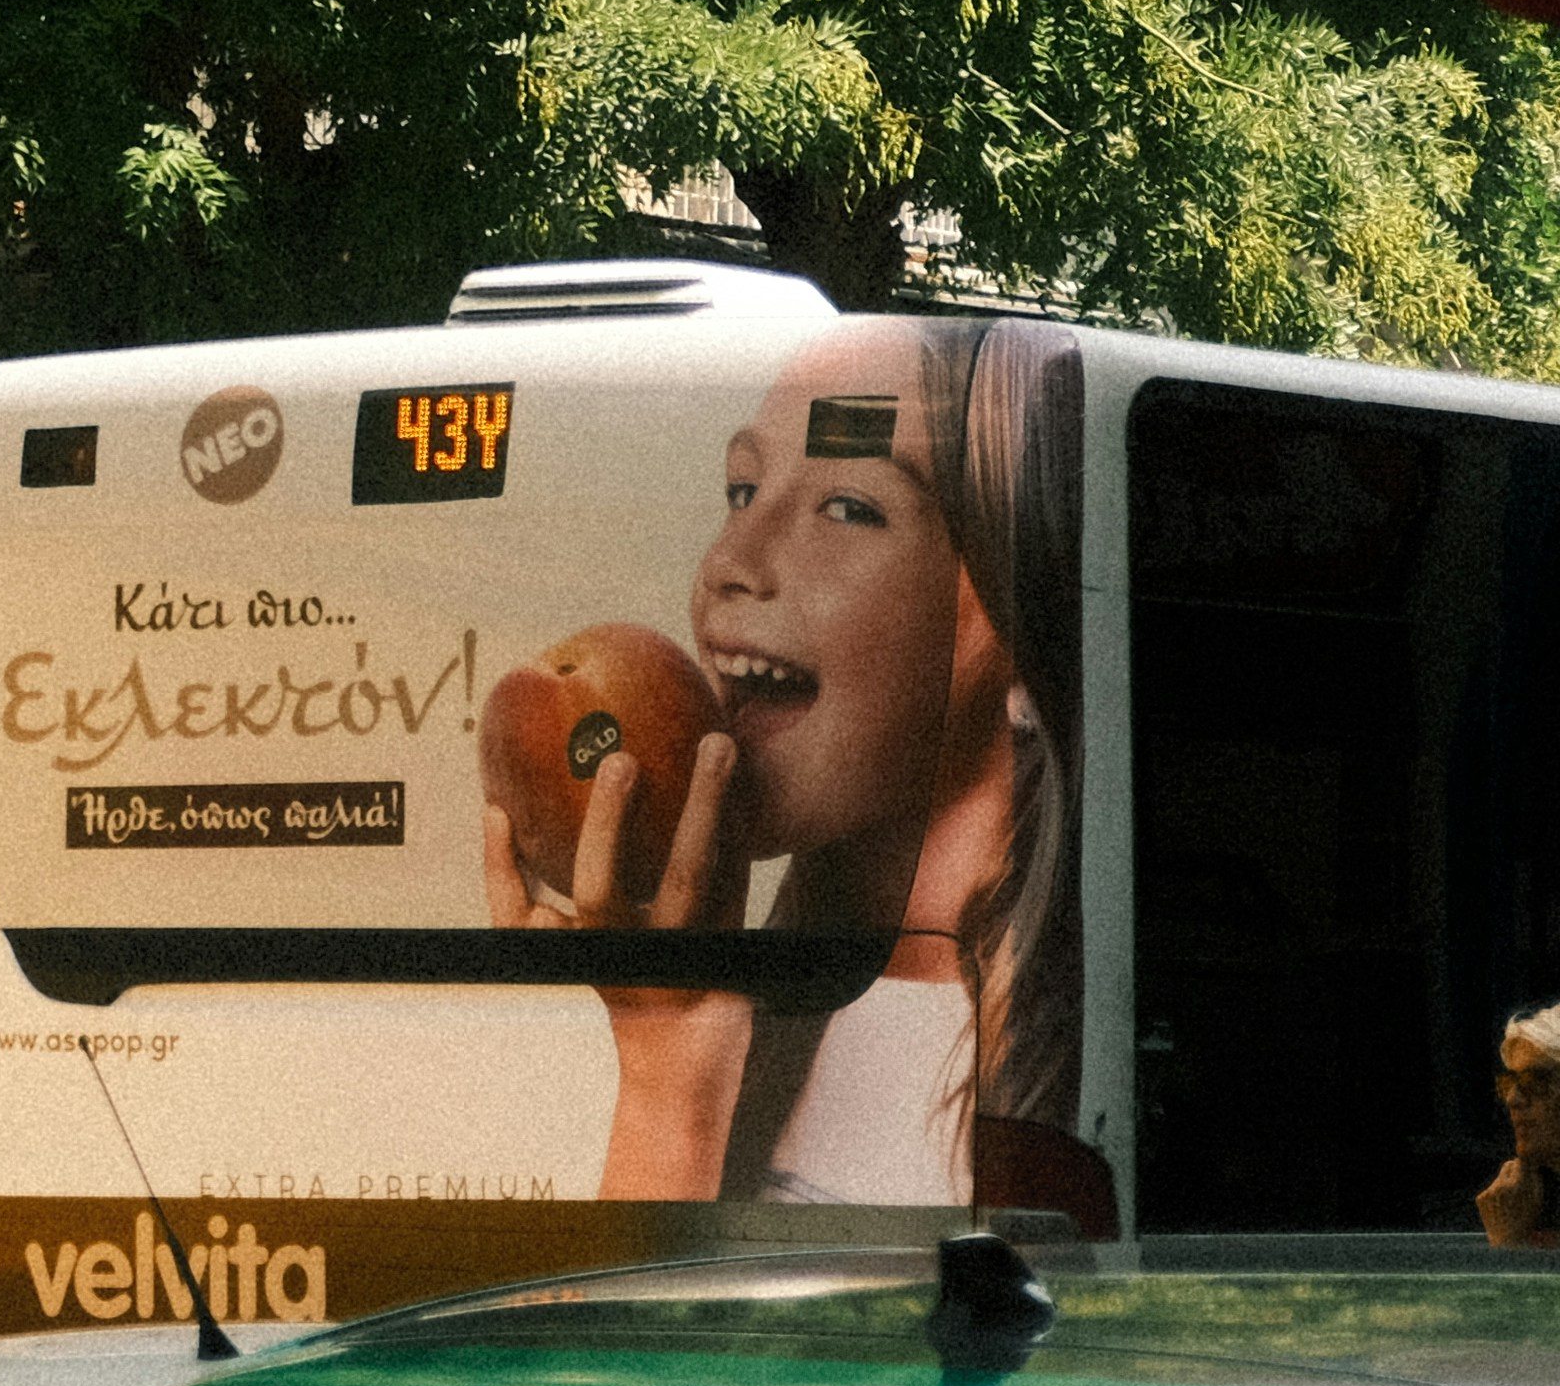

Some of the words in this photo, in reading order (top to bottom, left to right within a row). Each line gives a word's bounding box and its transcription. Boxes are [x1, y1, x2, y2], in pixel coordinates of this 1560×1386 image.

[112, 582, 229, 633] Κάτι
[0, 627, 478, 773] Εκλεκτόν!
[283, 787, 399, 840] παλιά!
[199, 1173, 326, 1202] EXTRA
[357, 1174, 555, 1203] PREMIUM
[23, 1211, 327, 1324] velvita
